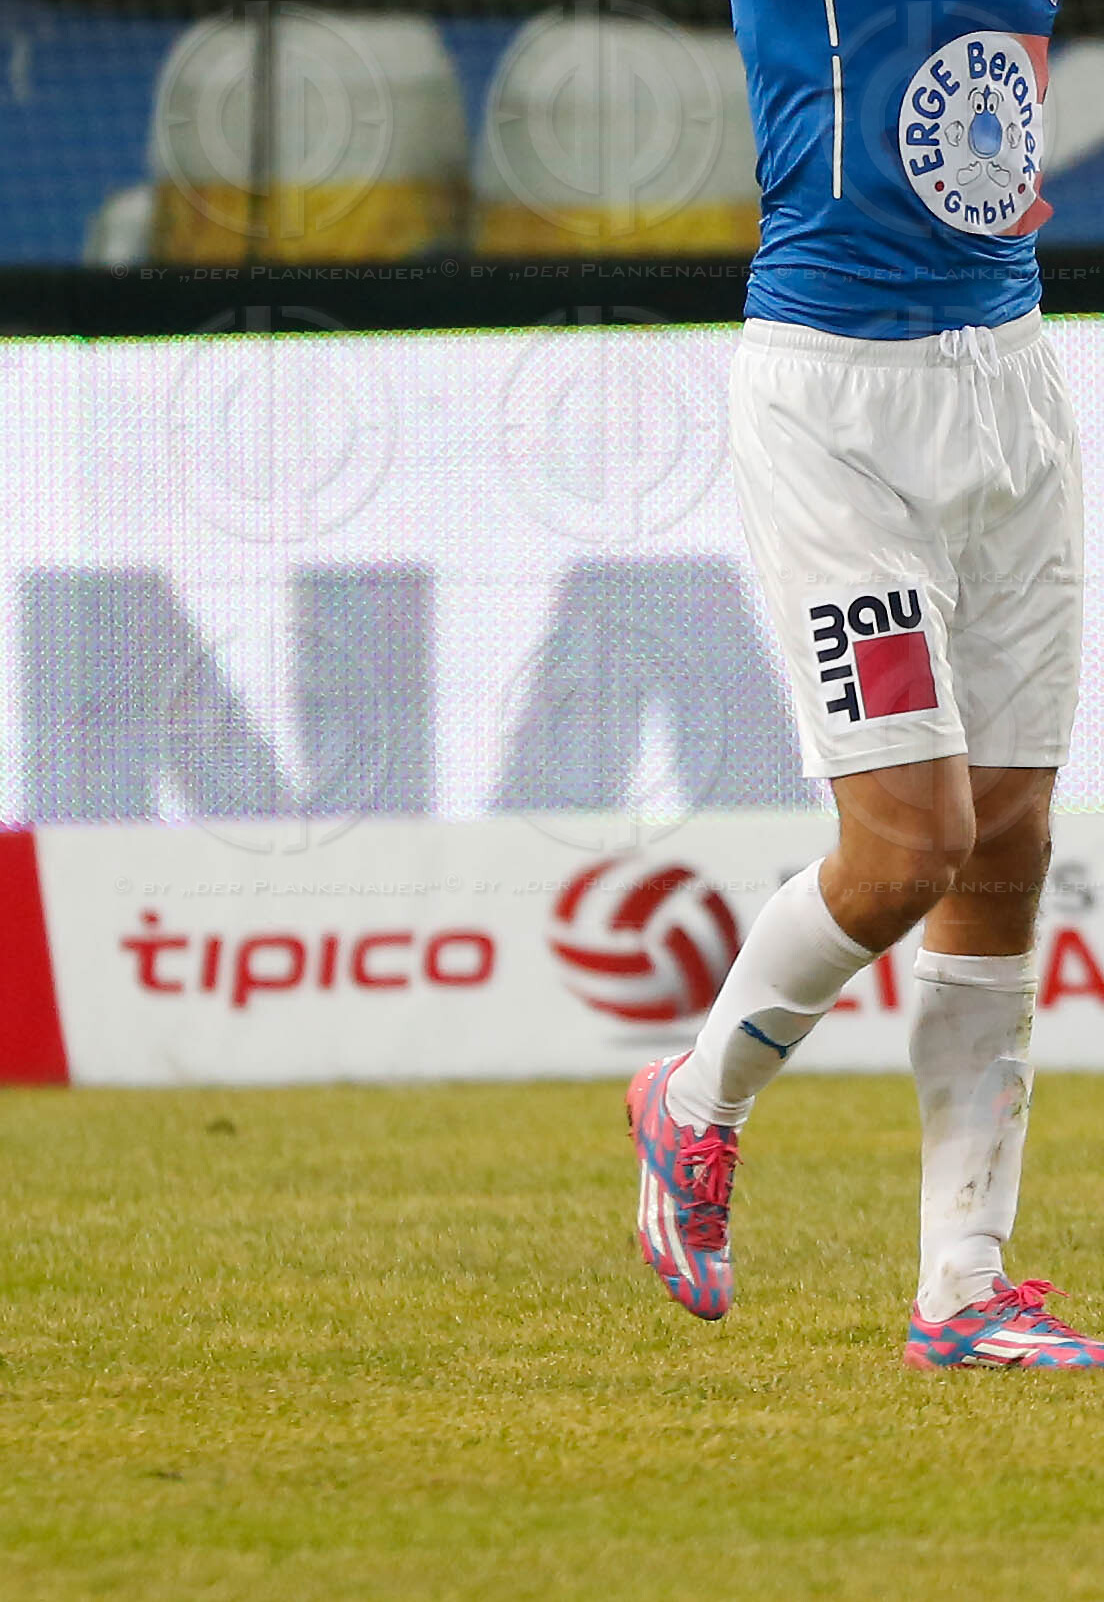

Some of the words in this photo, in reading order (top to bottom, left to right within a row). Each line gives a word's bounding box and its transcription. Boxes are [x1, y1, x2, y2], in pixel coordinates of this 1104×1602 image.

[906, 59, 961, 177] ERGE
[967, 41, 1037, 182] Beranek
[944, 190, 1015, 225] GmbH
[120, 909, 496, 1011] tipico
